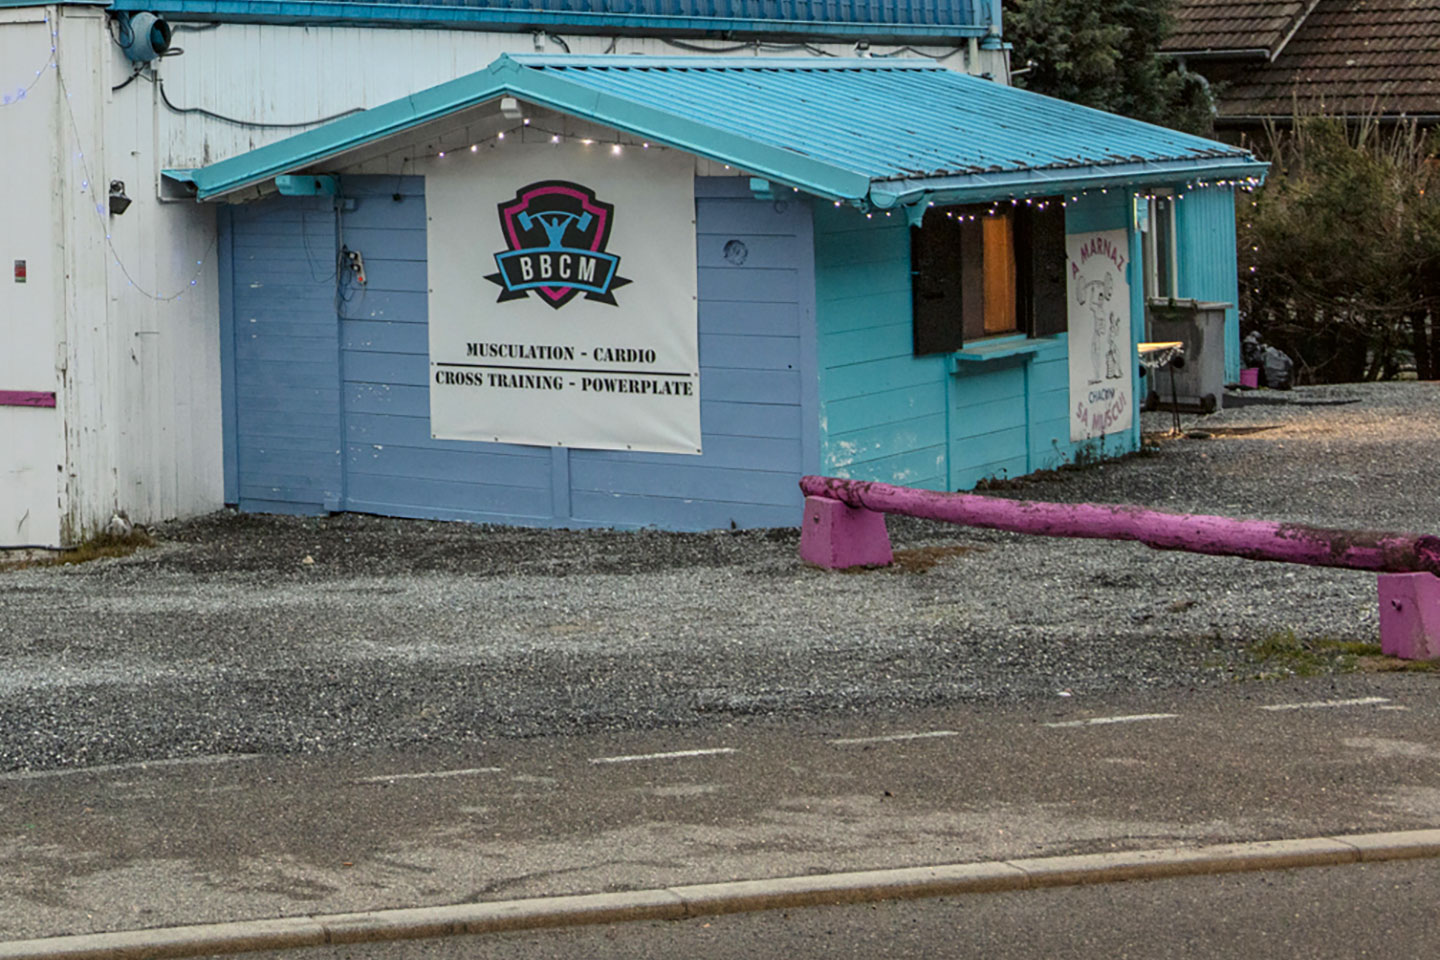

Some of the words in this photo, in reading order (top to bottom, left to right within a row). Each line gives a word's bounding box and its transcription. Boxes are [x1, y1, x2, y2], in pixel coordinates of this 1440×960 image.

[520, 254, 596, 282] BBCM
[1071, 261, 1079, 280] A
[1080, 237, 1125, 273] MARNAZ
[466, 342, 575, 361] MUSCULATION
[594, 347, 656, 364] CARDIO
[435, 371, 483, 387] CROSS
[487, 373, 563, 391] TRAINING
[581, 378, 694, 396] POWERPLATE
[1076, 401, 1088, 427] SA
